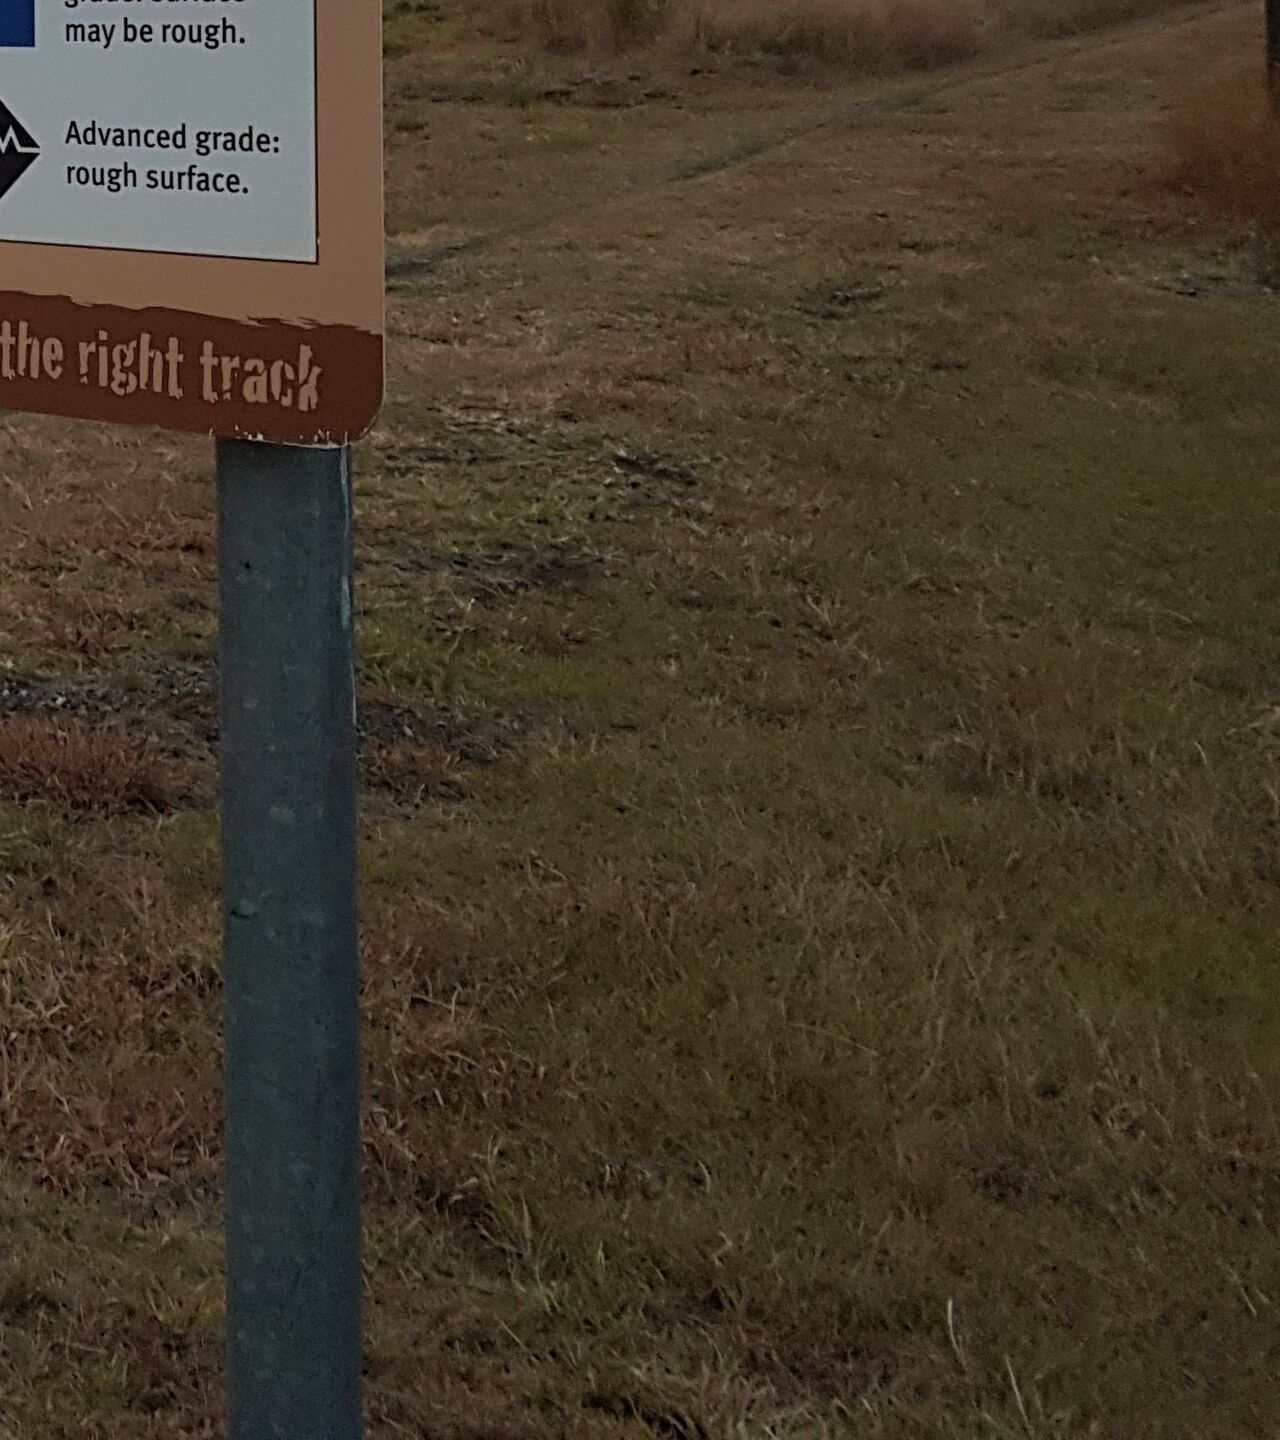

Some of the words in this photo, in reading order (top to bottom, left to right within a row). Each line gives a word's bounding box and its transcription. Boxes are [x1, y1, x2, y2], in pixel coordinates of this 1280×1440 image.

[65, 23, 116, 49] may
[123, 16, 154, 43] be
[162, 16, 246, 50] rough.
[65, 120, 187, 150] Advanced
[195, 125, 280, 157] grade:
[67, 161, 137, 193] rough
[146, 164, 249, 194] surface.
[78, 329, 184, 399] right
[199, 340, 322, 412] track
